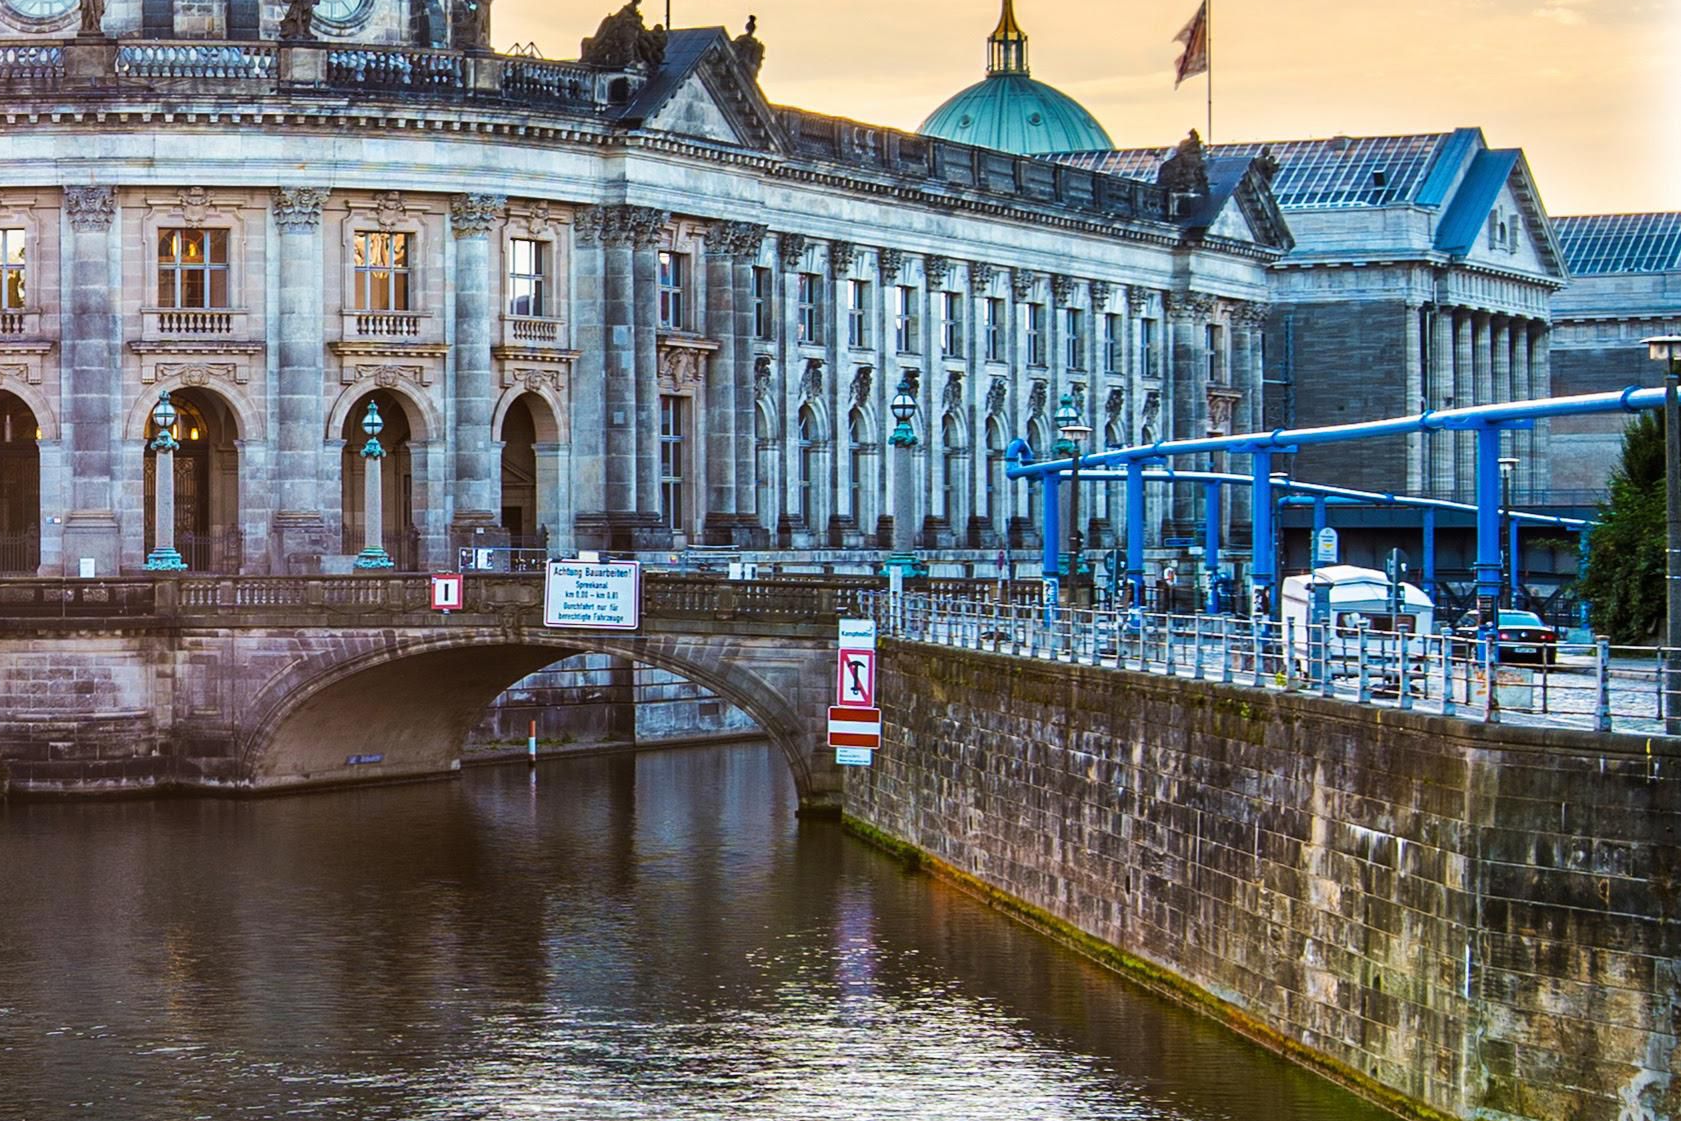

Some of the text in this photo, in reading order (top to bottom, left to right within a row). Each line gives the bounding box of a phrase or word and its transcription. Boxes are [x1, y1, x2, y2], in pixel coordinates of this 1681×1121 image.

[554, 567, 632, 579] Achtung Bauarbeiten!
[576, 581, 608, 590] Spreekanal
[565, 590, 575, 598] km
[596, 591, 605, 599] km
[564, 601, 595, 611] Durchfahrt
[610, 603, 619, 611] für
[559, 612, 624, 623] berechtigte Fahrzeuge
